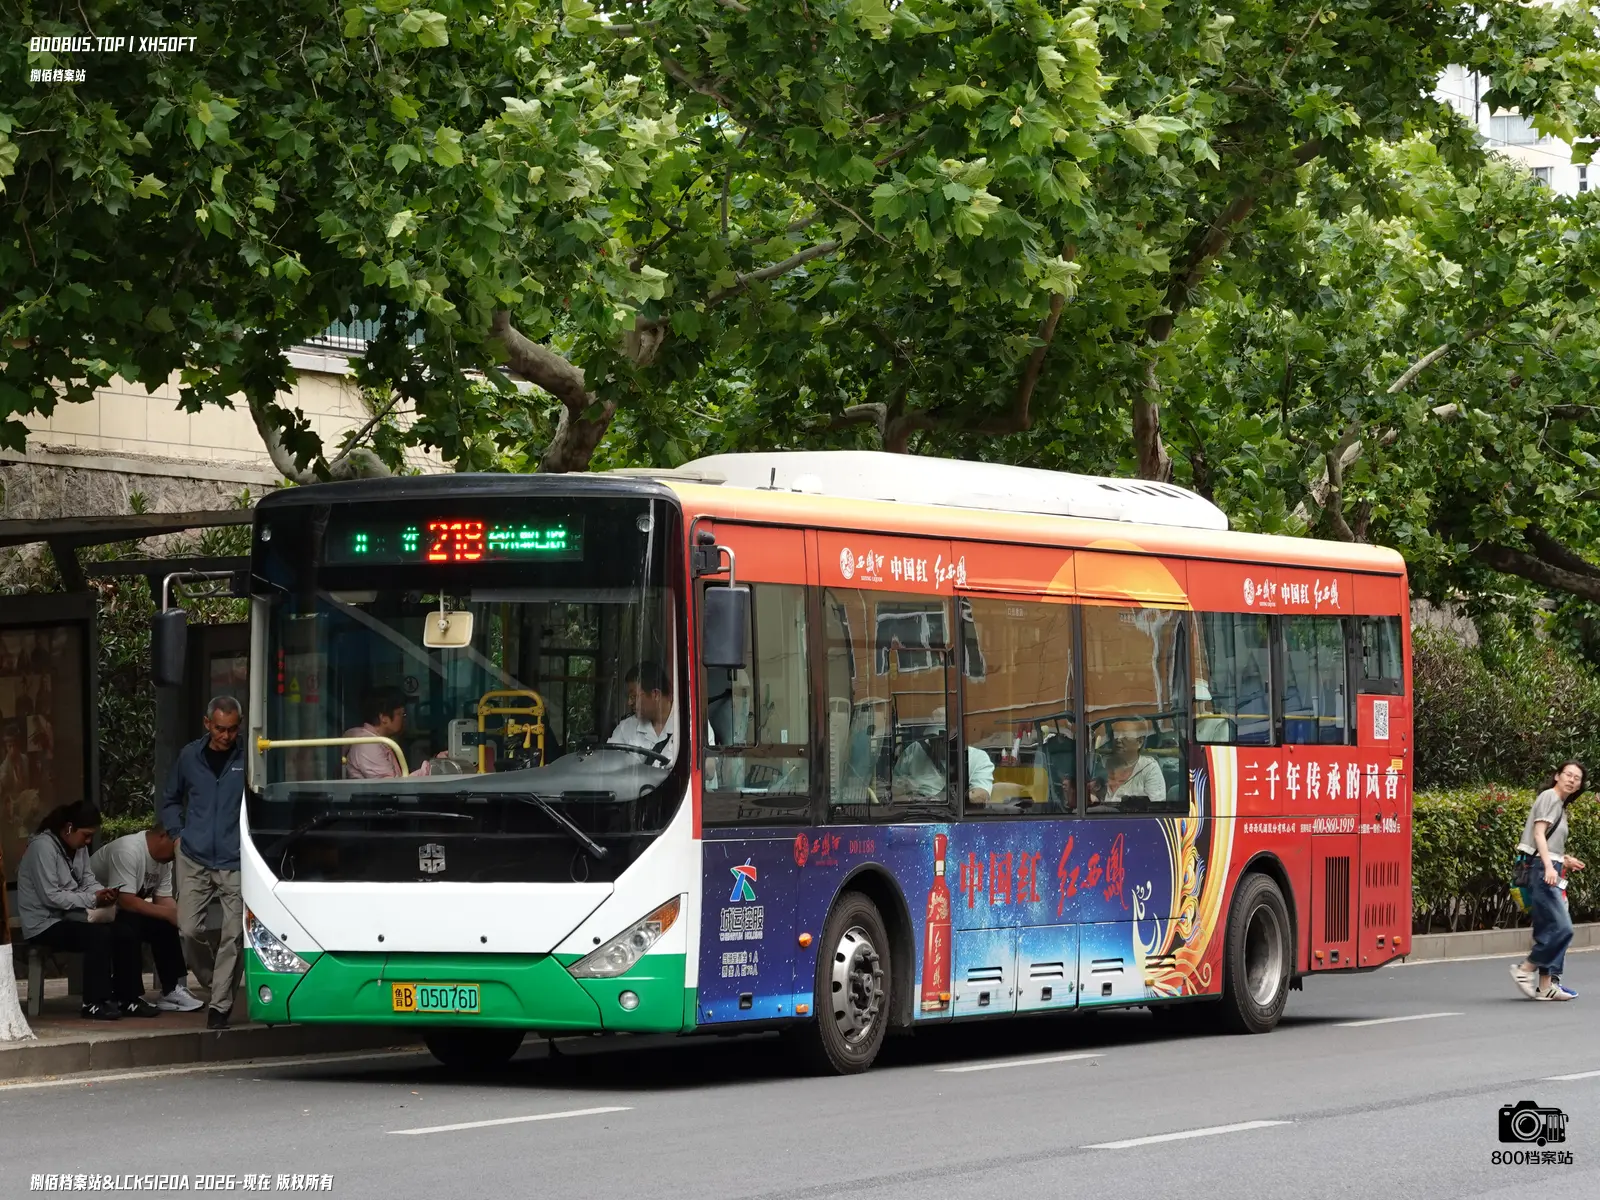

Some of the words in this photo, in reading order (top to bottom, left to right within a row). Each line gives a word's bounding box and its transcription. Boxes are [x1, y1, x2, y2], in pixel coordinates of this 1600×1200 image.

[890, 555, 928, 582] 中国红
[1281, 582, 1309, 605] 中国红
[959, 850, 1041, 909] 中国红
[719, 905, 764, 932] 城运控股
